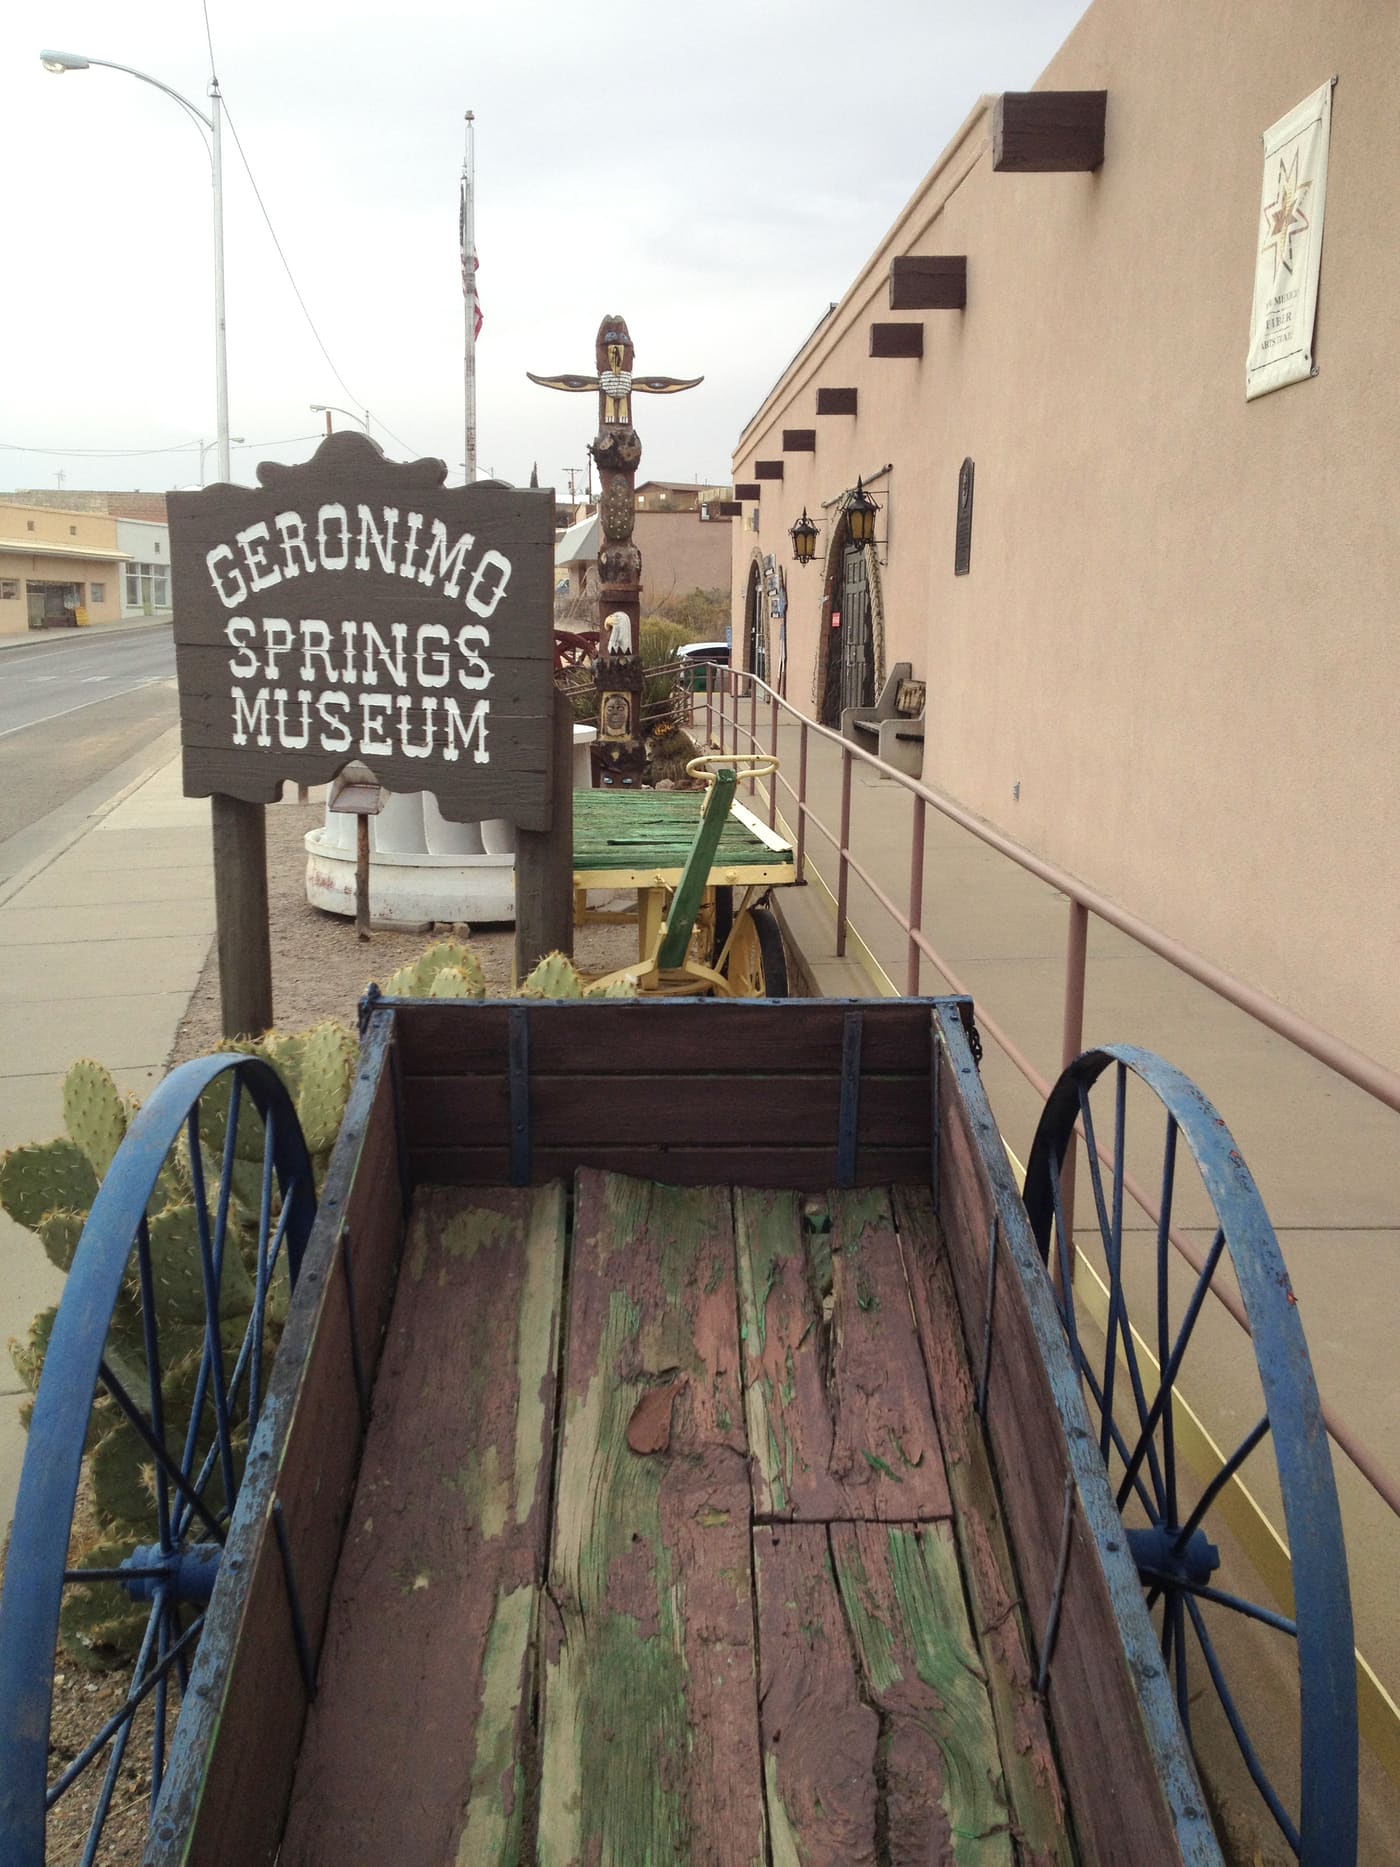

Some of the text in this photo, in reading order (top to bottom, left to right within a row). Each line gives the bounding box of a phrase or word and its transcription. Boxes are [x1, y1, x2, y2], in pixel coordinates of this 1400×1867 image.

[206, 502, 512, 618] GERONIMO
[225, 616, 495, 690] SPRINGS
[231, 686, 491, 764] MUSEUM
